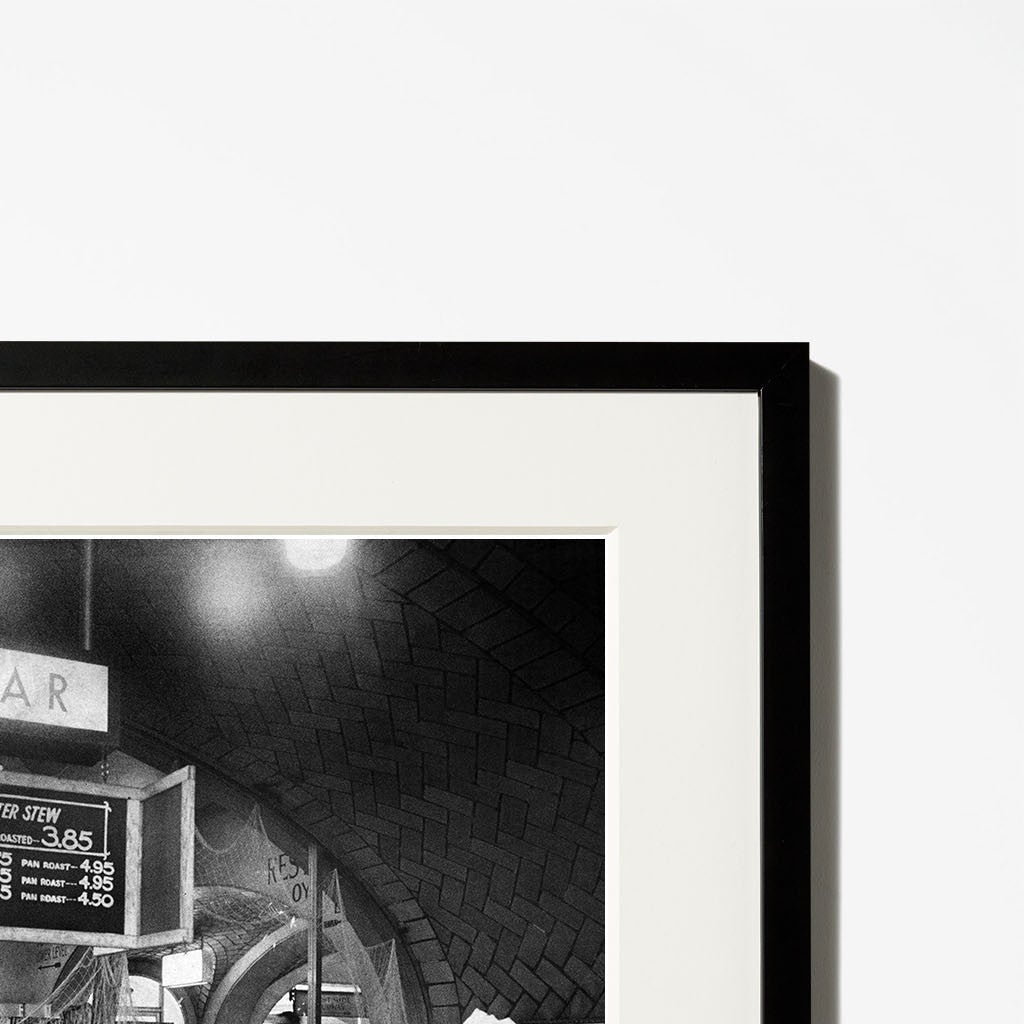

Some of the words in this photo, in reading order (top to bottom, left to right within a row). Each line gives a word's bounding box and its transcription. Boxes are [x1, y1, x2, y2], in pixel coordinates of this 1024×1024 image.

[22, 805, 62, 824] STEW
[41, 825, 93, 851] 3.85
[21, 859, 40, 869] PAN
[43, 861, 71, 871] ROAST
[79, 859, 115, 876] 4.95
[21, 876, 38, 886] PAN
[40, 878, 66, 888] ROAST
[78, 875, 114, 892] 4.95
[21, 892, 38, 902] PAN
[40, 894, 67, 904] ROAST
[77, 892, 114, 908] 4.50
